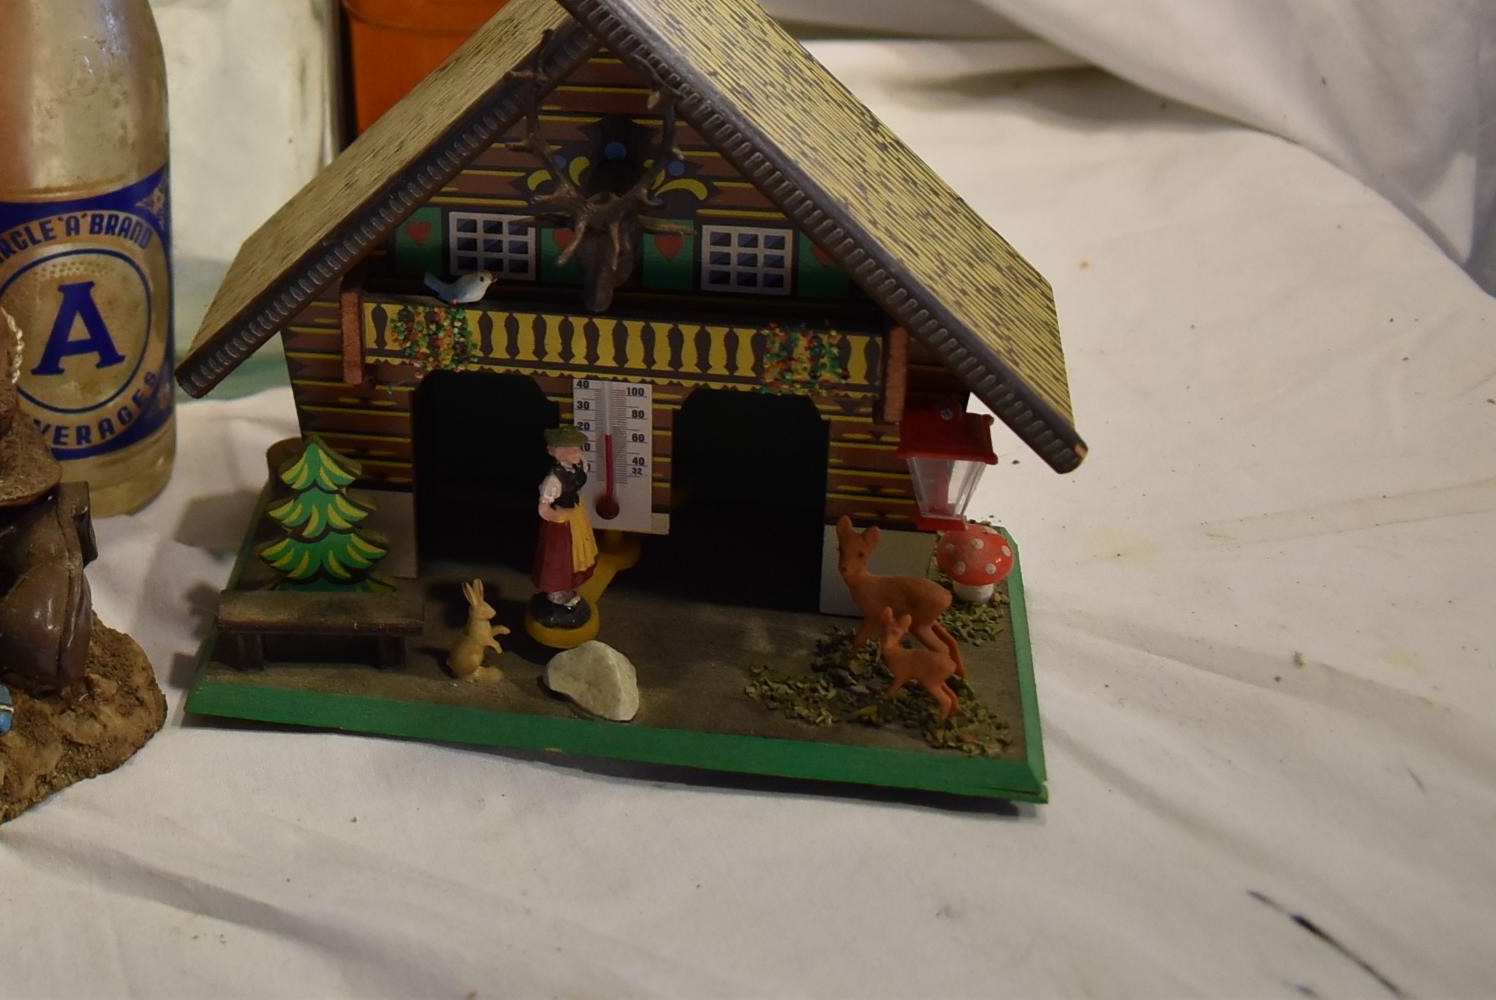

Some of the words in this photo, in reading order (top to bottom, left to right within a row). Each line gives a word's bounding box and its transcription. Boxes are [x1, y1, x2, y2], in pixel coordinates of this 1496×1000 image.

[89, 213, 154, 250] BRAND
[30, 280, 126, 376] A
[576, 380, 590, 389] 40
[627, 387, 644, 397] 100
[33, 370, 157, 446] VERAGES
[576, 401, 590, 410] 30
[632, 410, 644, 419] 80
[577, 422, 590, 431] 20
[632, 433, 644, 442] 60
[632, 457, 644, 466] 40
[632, 467, 643, 476] 32
